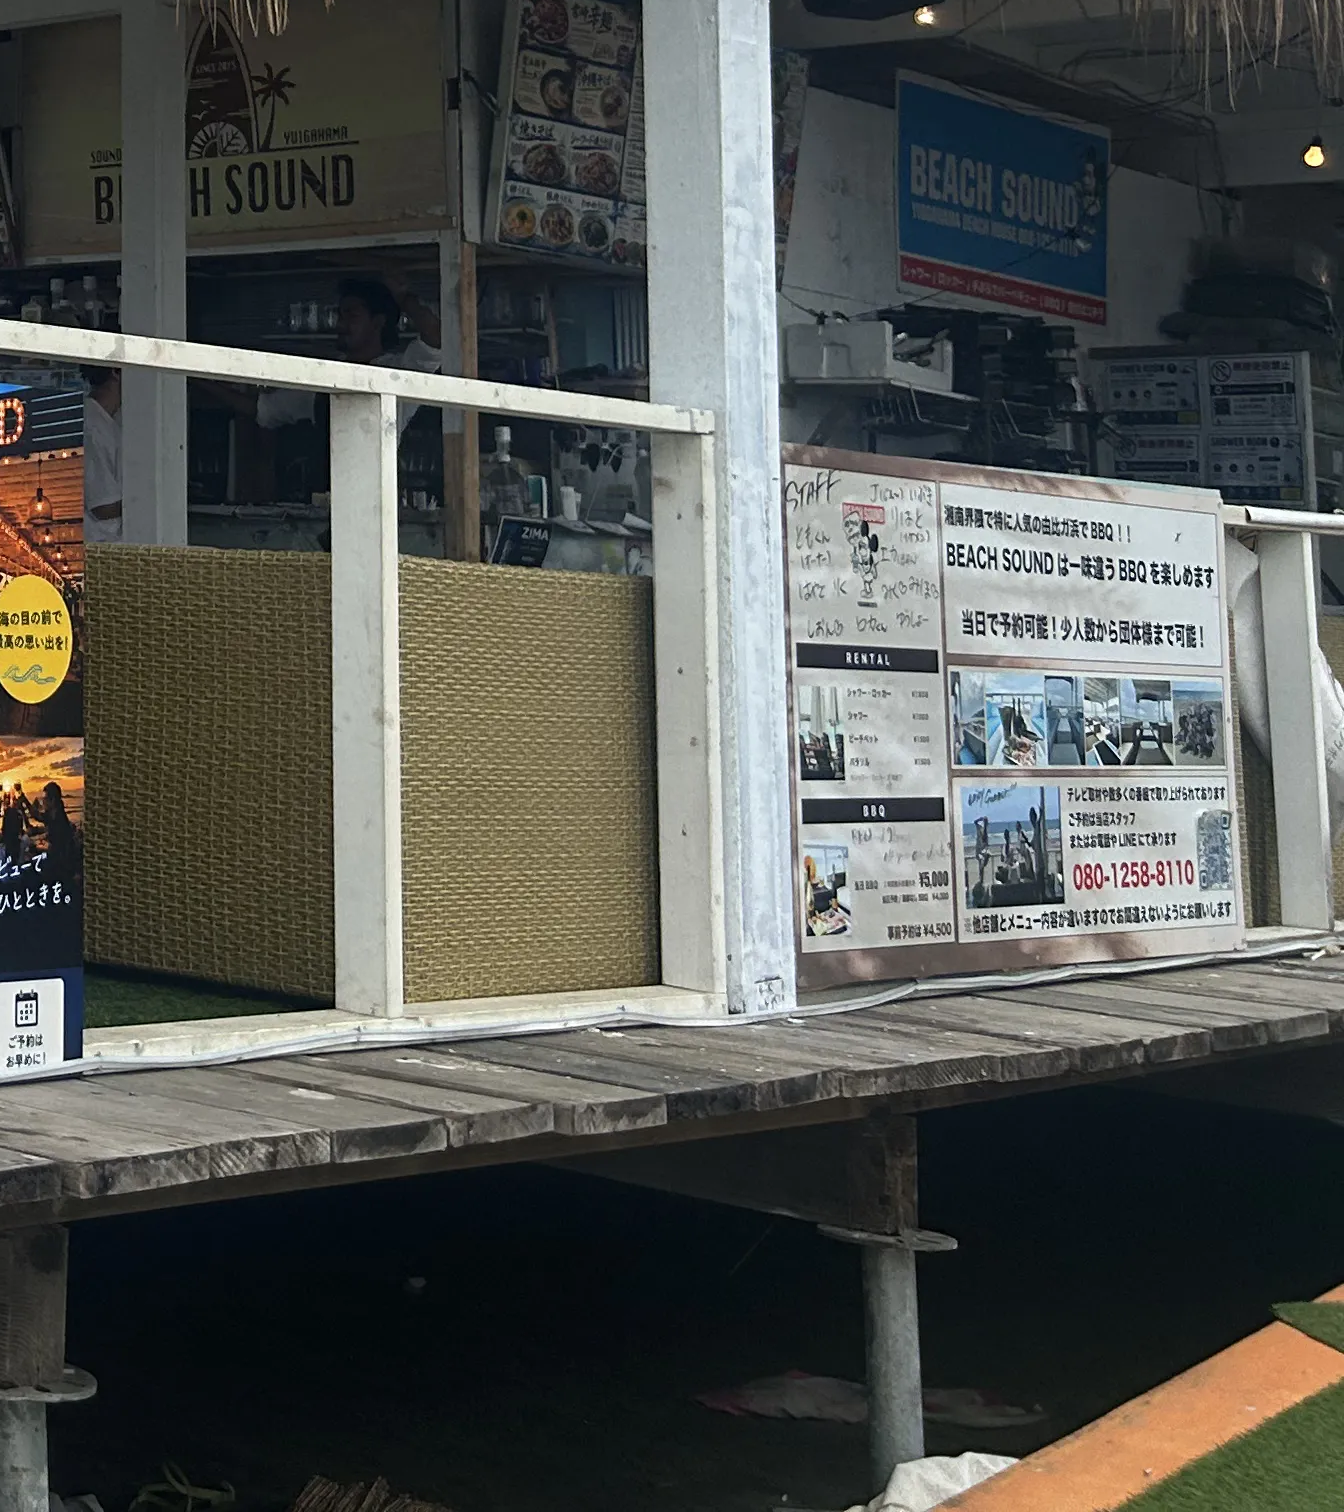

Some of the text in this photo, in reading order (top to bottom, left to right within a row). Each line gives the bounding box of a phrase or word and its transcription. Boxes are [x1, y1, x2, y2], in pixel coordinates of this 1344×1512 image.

[283, 125, 348, 145] YUIGAHAMA
[224, 154, 355, 216] SOUND
[911, 144, 1079, 232] BEACH SOUND
[784, 469, 841, 512] STAFF
[521, 526, 549, 541] ZIMA
[946, 542, 998, 570] BEACH
[1002, 548, 1054, 575] SOUND
[1057, 552, 1115, 581] は一味違う
[1119, 559, 1147, 584] BBQ
[1149, 561, 1214, 589] を楽しめます
[845, 651, 891, 667] RENTAL
[862, 804, 886, 819] BBQ
[1068, 811, 1137, 828] ご予約は当店スタッフ
[1118, 833, 1138, 848] LINE
[918, 870, 949, 888] ¥5,000
[1072, 859, 1195, 891] 080-1258-8110
[922, 922, 952, 938] ¥4,500
[8, 1033, 44, 1049] ご予約は
[6, 1051, 47, 1068] お早めに!
